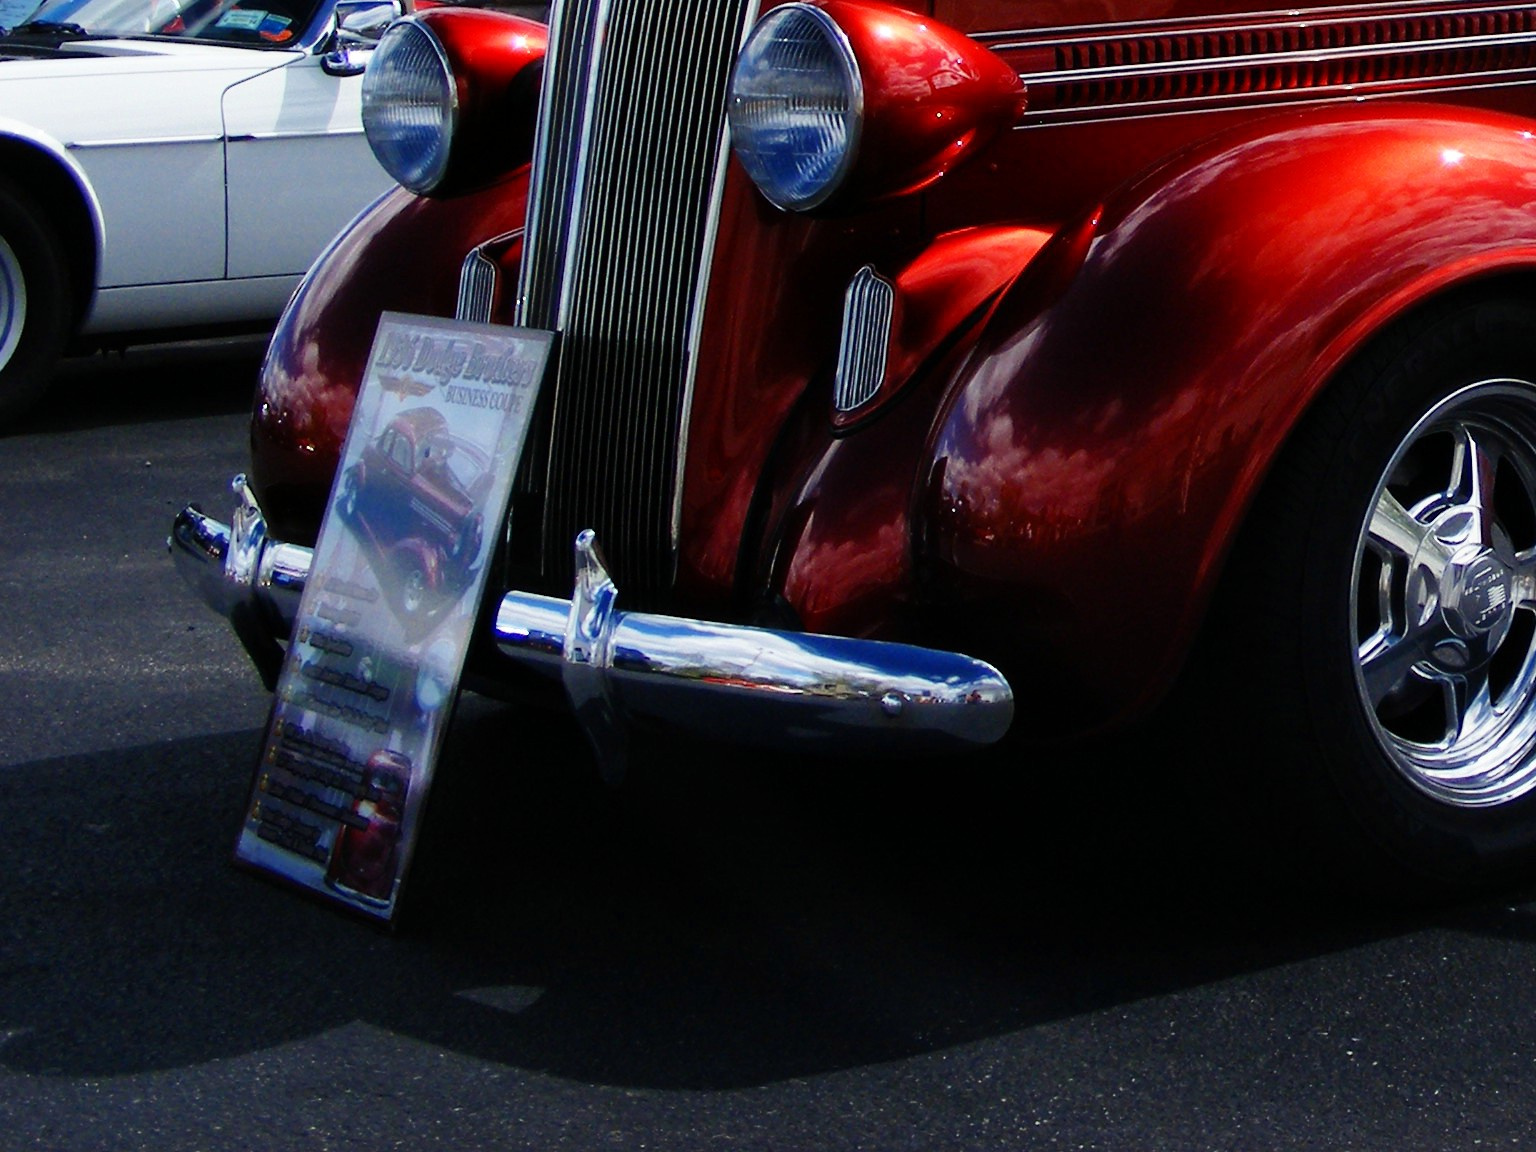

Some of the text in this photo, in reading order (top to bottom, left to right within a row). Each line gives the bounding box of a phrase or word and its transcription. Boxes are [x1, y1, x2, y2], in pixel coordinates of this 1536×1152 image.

[412, 336, 468, 387] Dodge
[462, 342, 538, 388] Brothers
[445, 385, 492, 408] BUSINESS
